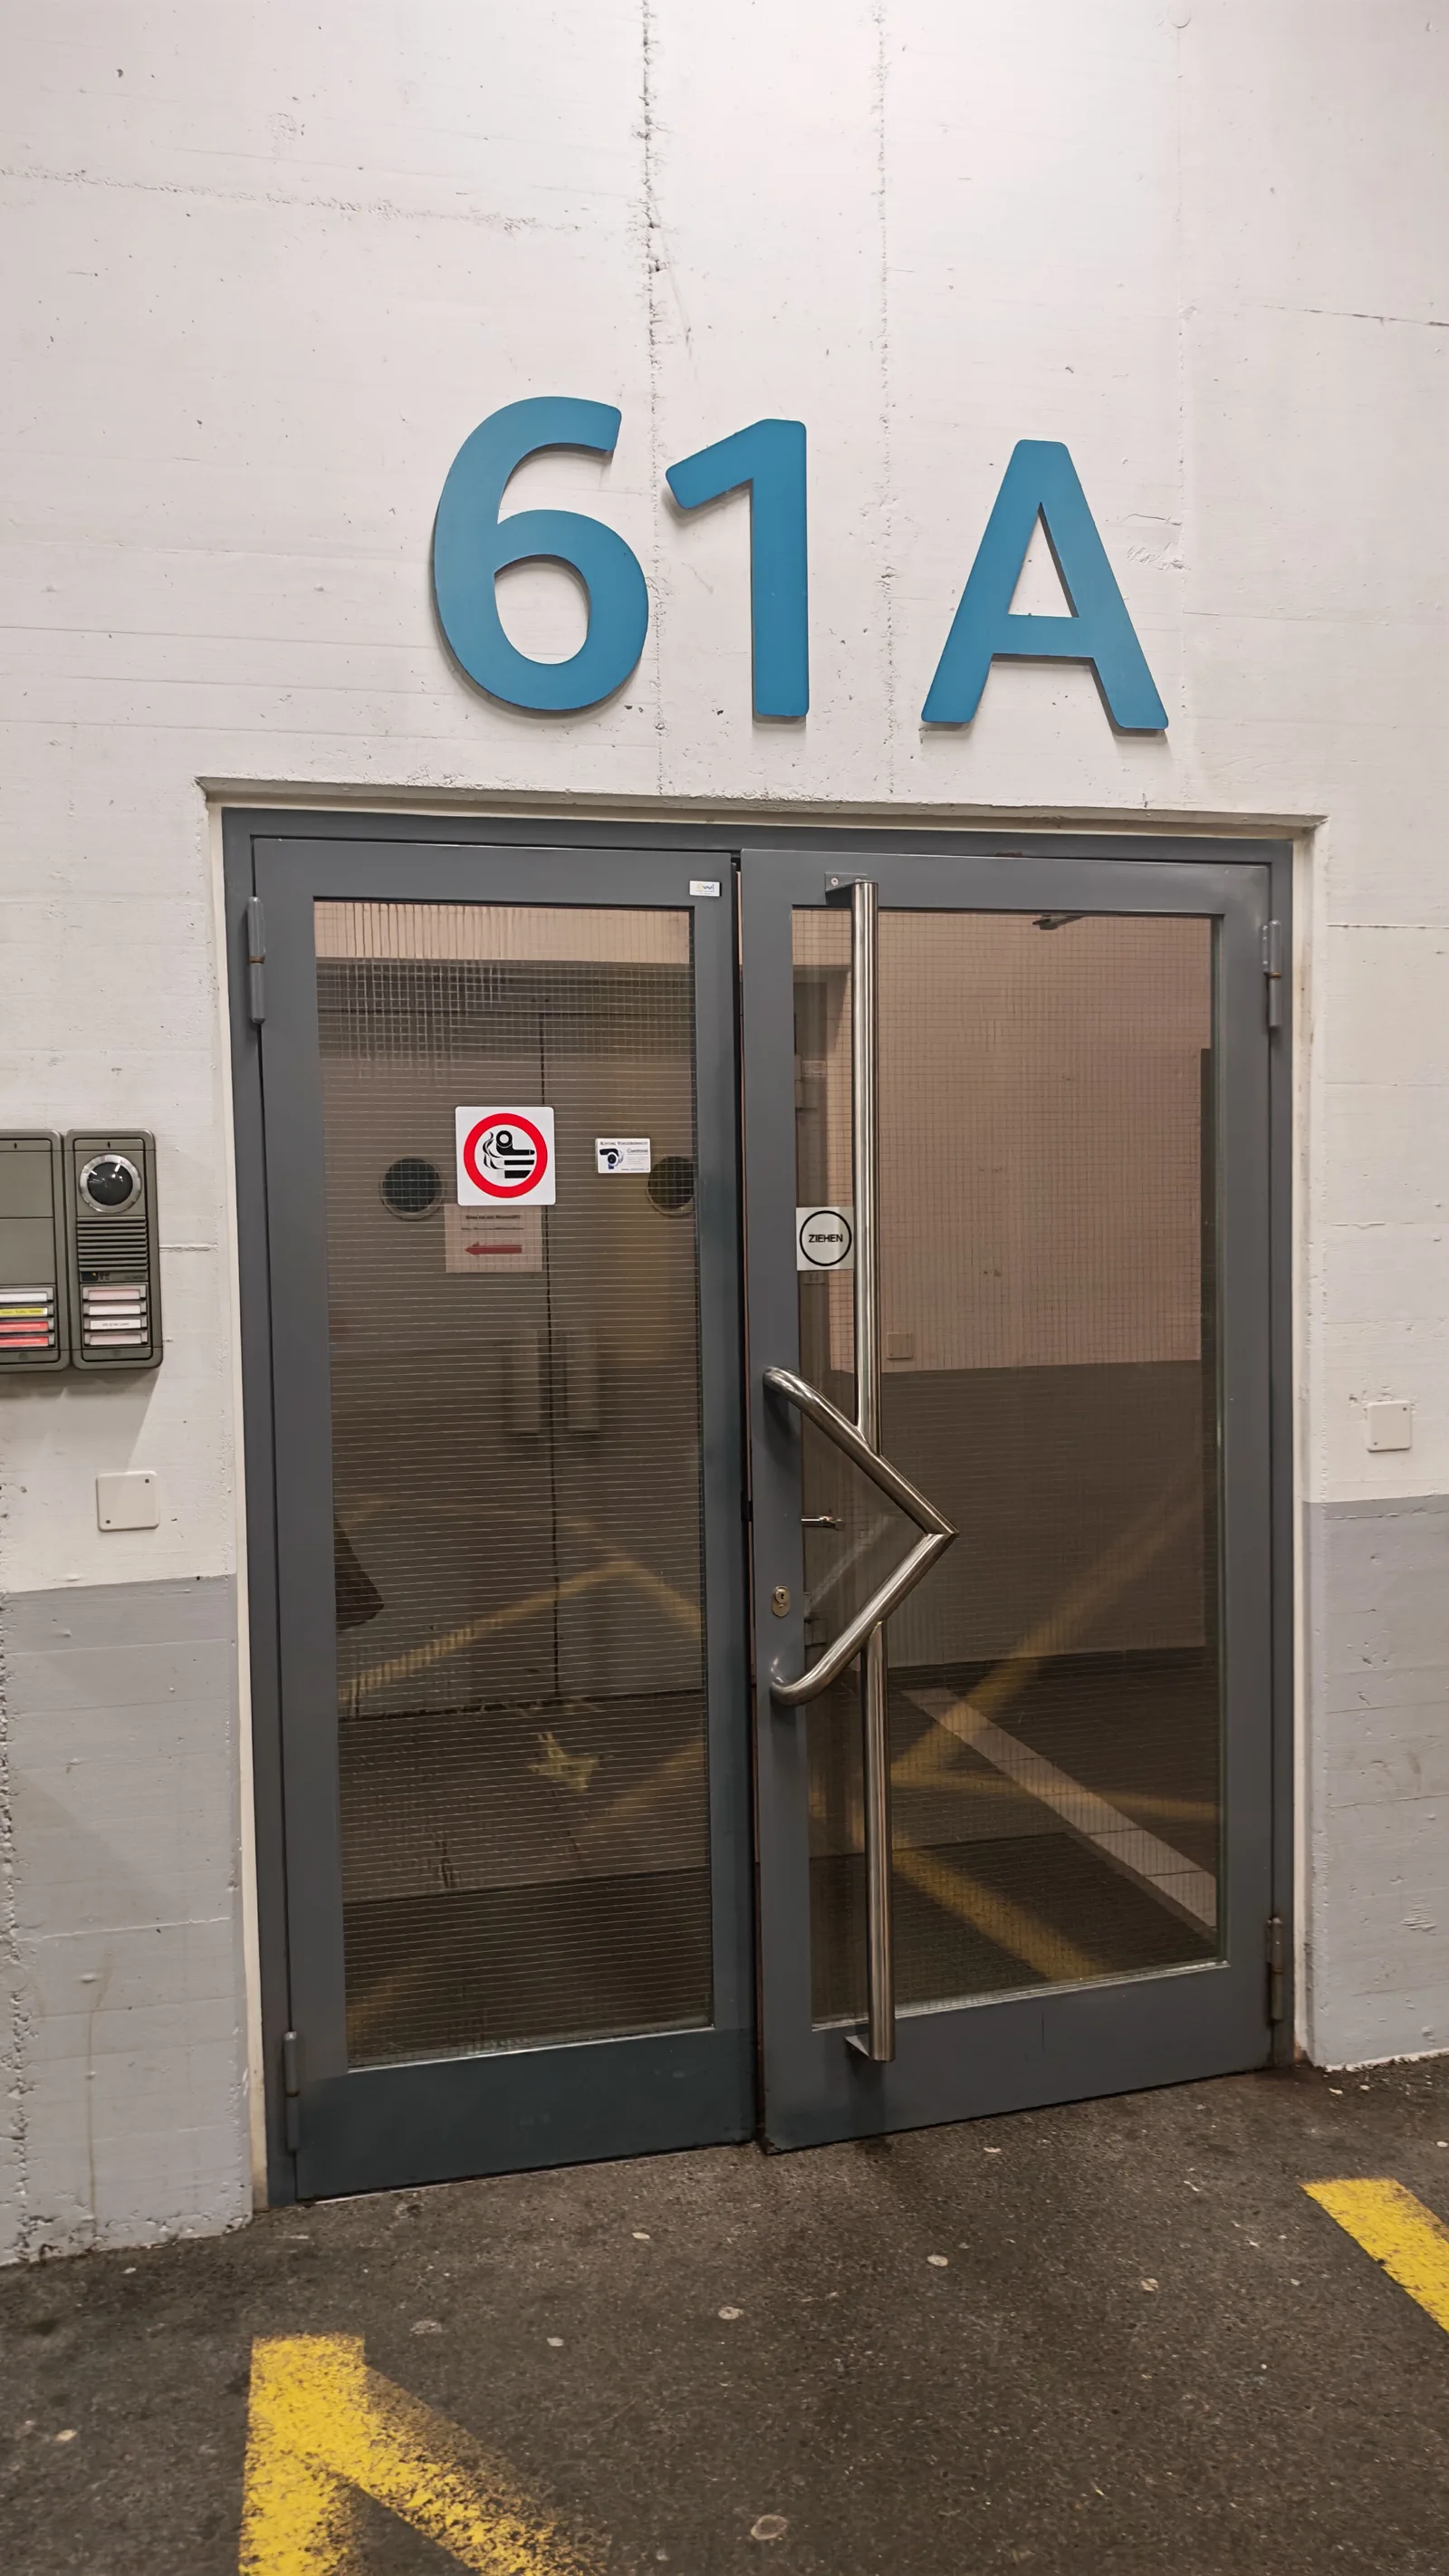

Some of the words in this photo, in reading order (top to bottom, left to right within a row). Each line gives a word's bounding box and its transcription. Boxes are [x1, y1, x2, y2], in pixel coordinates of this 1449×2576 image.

[433, 396, 811, 717] 61
[921, 438, 1169, 730] A
[808, 1234, 844, 1244] ZIEHEN
